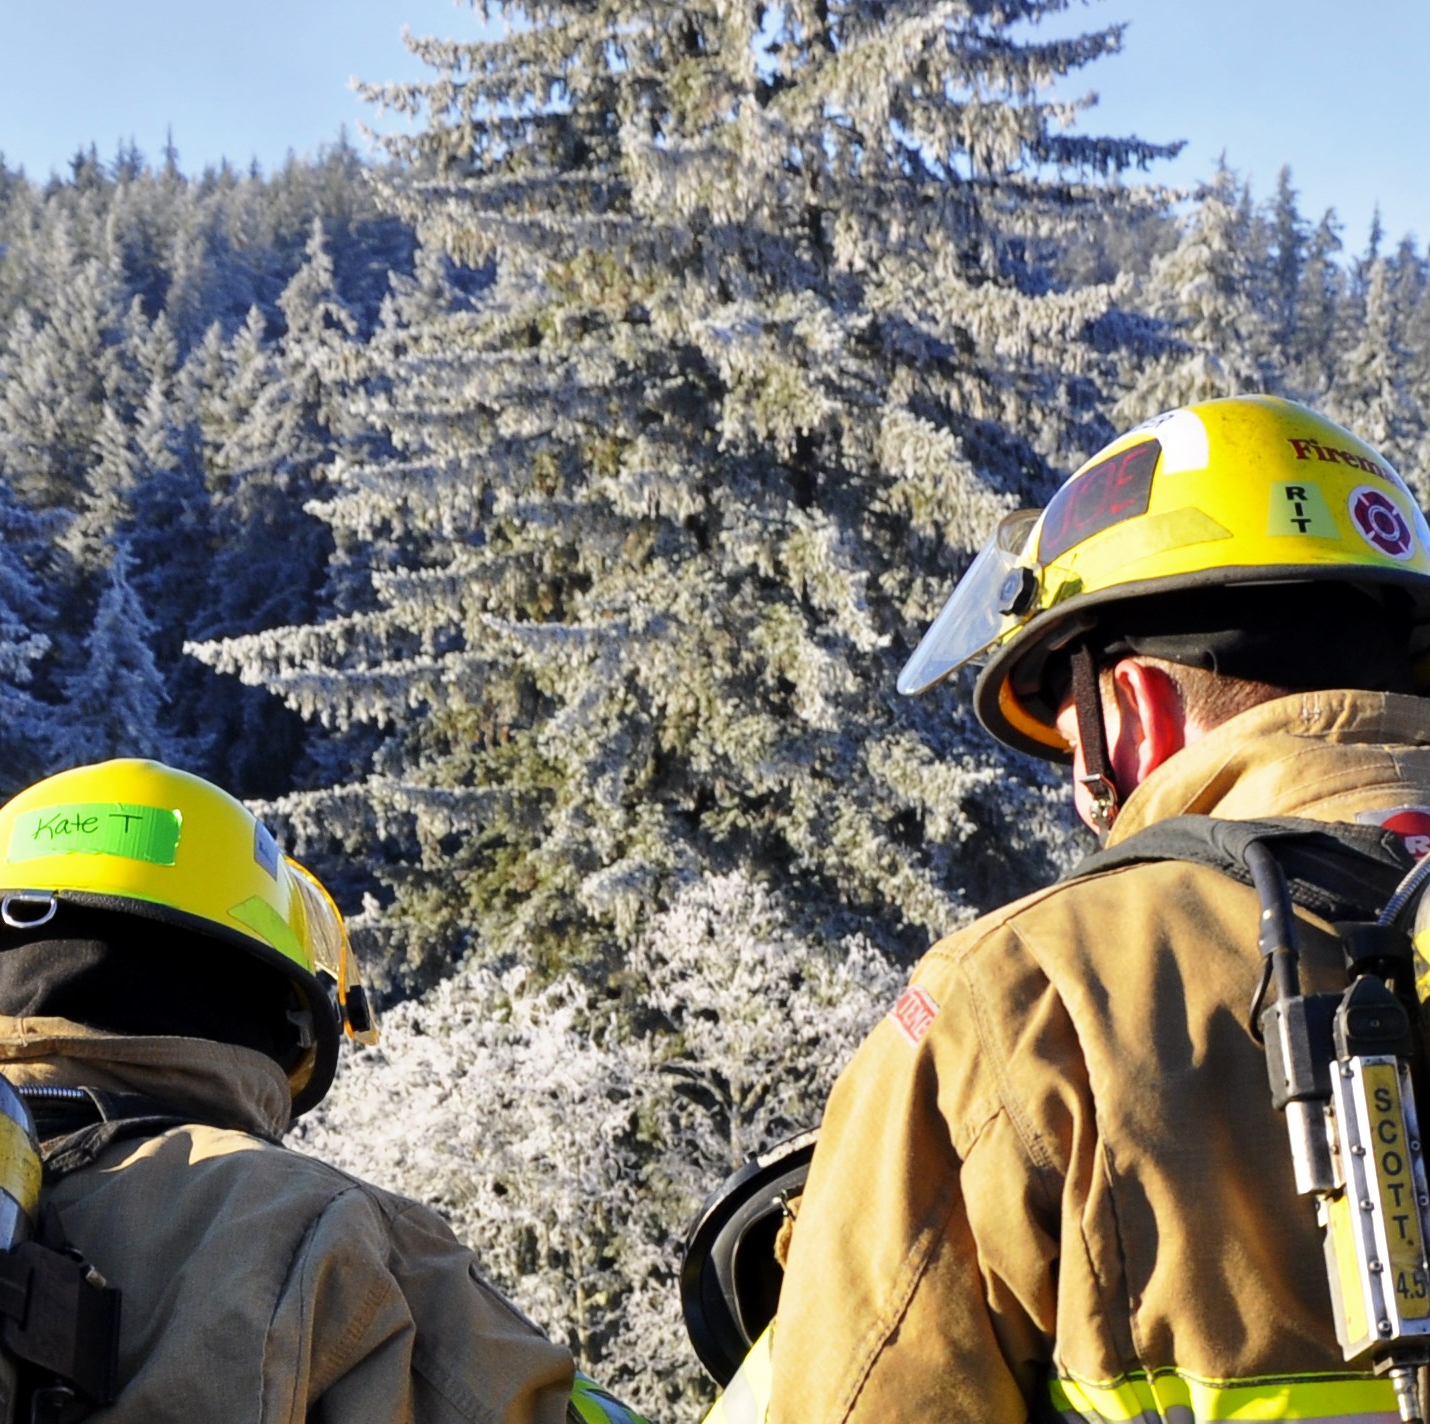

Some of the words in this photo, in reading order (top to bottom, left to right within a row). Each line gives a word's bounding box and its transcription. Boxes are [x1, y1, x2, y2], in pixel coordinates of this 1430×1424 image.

[1285, 486, 1312, 534] RIT
[33, 811, 100, 842] Kate
[108, 813, 144, 835] T
[1372, 1086, 1410, 1241] SCOTT
[1396, 1271, 1428, 1300] 4.5
